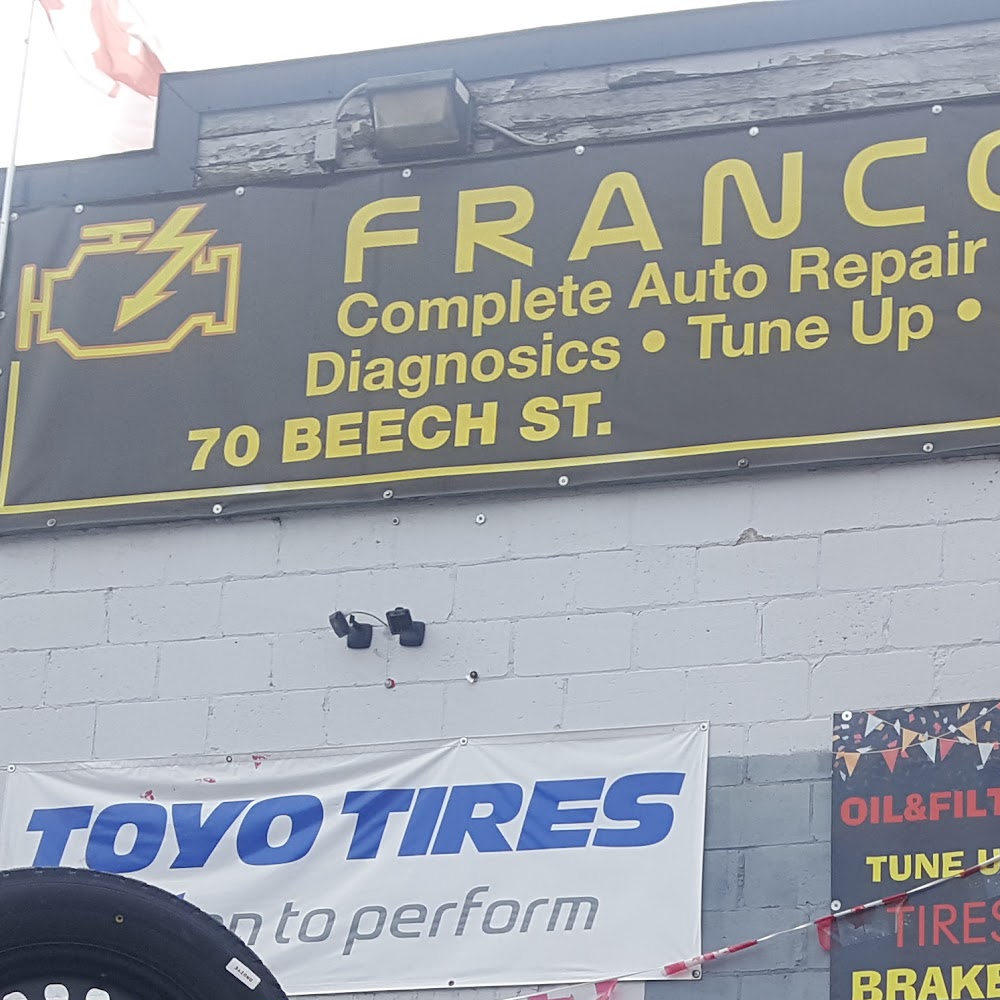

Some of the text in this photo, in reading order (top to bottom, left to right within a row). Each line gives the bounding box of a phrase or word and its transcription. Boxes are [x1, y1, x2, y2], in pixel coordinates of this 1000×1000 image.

[337, 230, 988, 338] Complete Auto Repair
[305, 332, 621, 400] Diagnosics
[687, 313, 830, 360] Tune
[850, 299, 935, 352] Up
[186, 391, 613, 470] 70 BEECH ST.
[26, 771, 687, 873] TOYO TIRES
[866, 850, 964, 882] TUNE
[275, 901, 334, 944] to
[342, 885, 600, 956] perform
